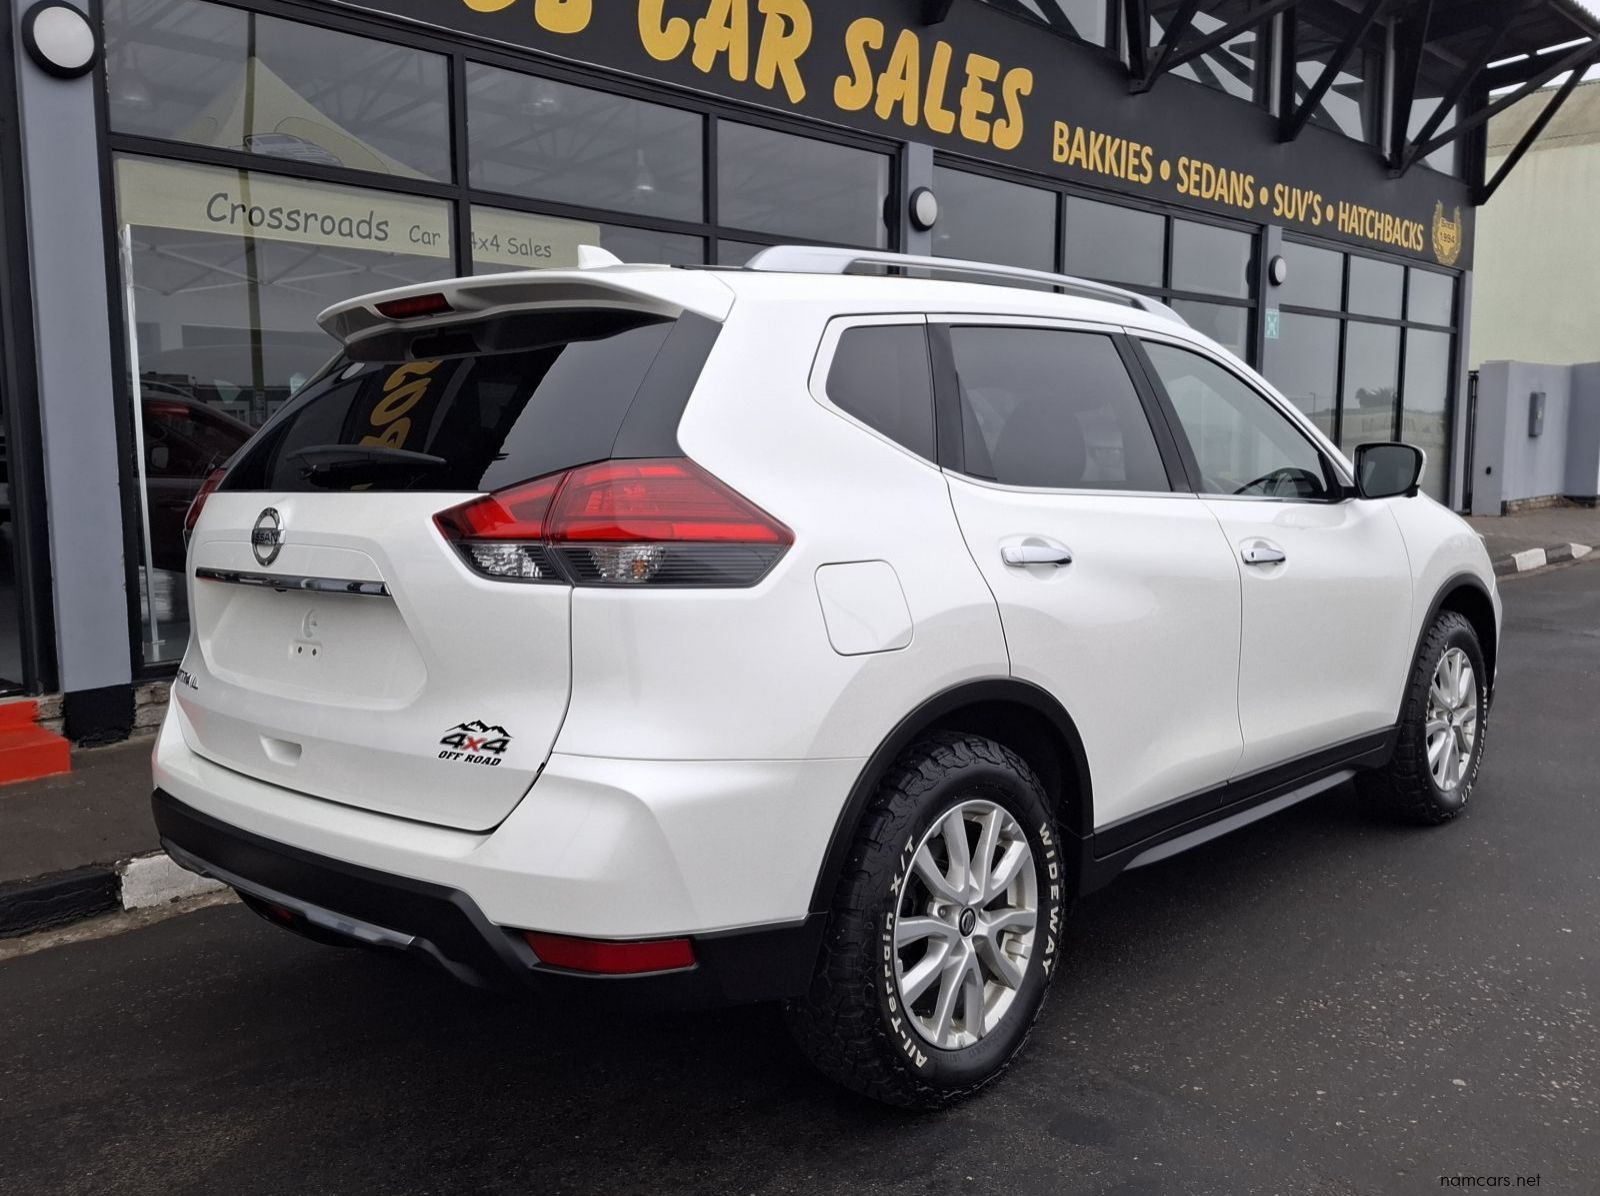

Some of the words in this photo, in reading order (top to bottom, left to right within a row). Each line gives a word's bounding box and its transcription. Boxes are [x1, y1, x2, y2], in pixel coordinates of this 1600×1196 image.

[637, 0, 813, 104] CAR
[833, 17, 1034, 151] SALES
[206, 193, 389, 242] Crossroads
[409, 225, 441, 247] Car
[507, 237, 552, 258] Sales
[1052, 120, 1154, 185] BAKKIES
[1177, 156, 1255, 210] SEDANS
[1273, 183, 1322, 226] SUV'S
[1338, 201, 1424, 251] HATCHBACKS
[438, 750, 464, 761] OFF
[464, 754, 502, 766] ROAD
[1038, 822, 1060, 976] WIDEWAY
[882, 912, 928, 1069] All-Terrain
